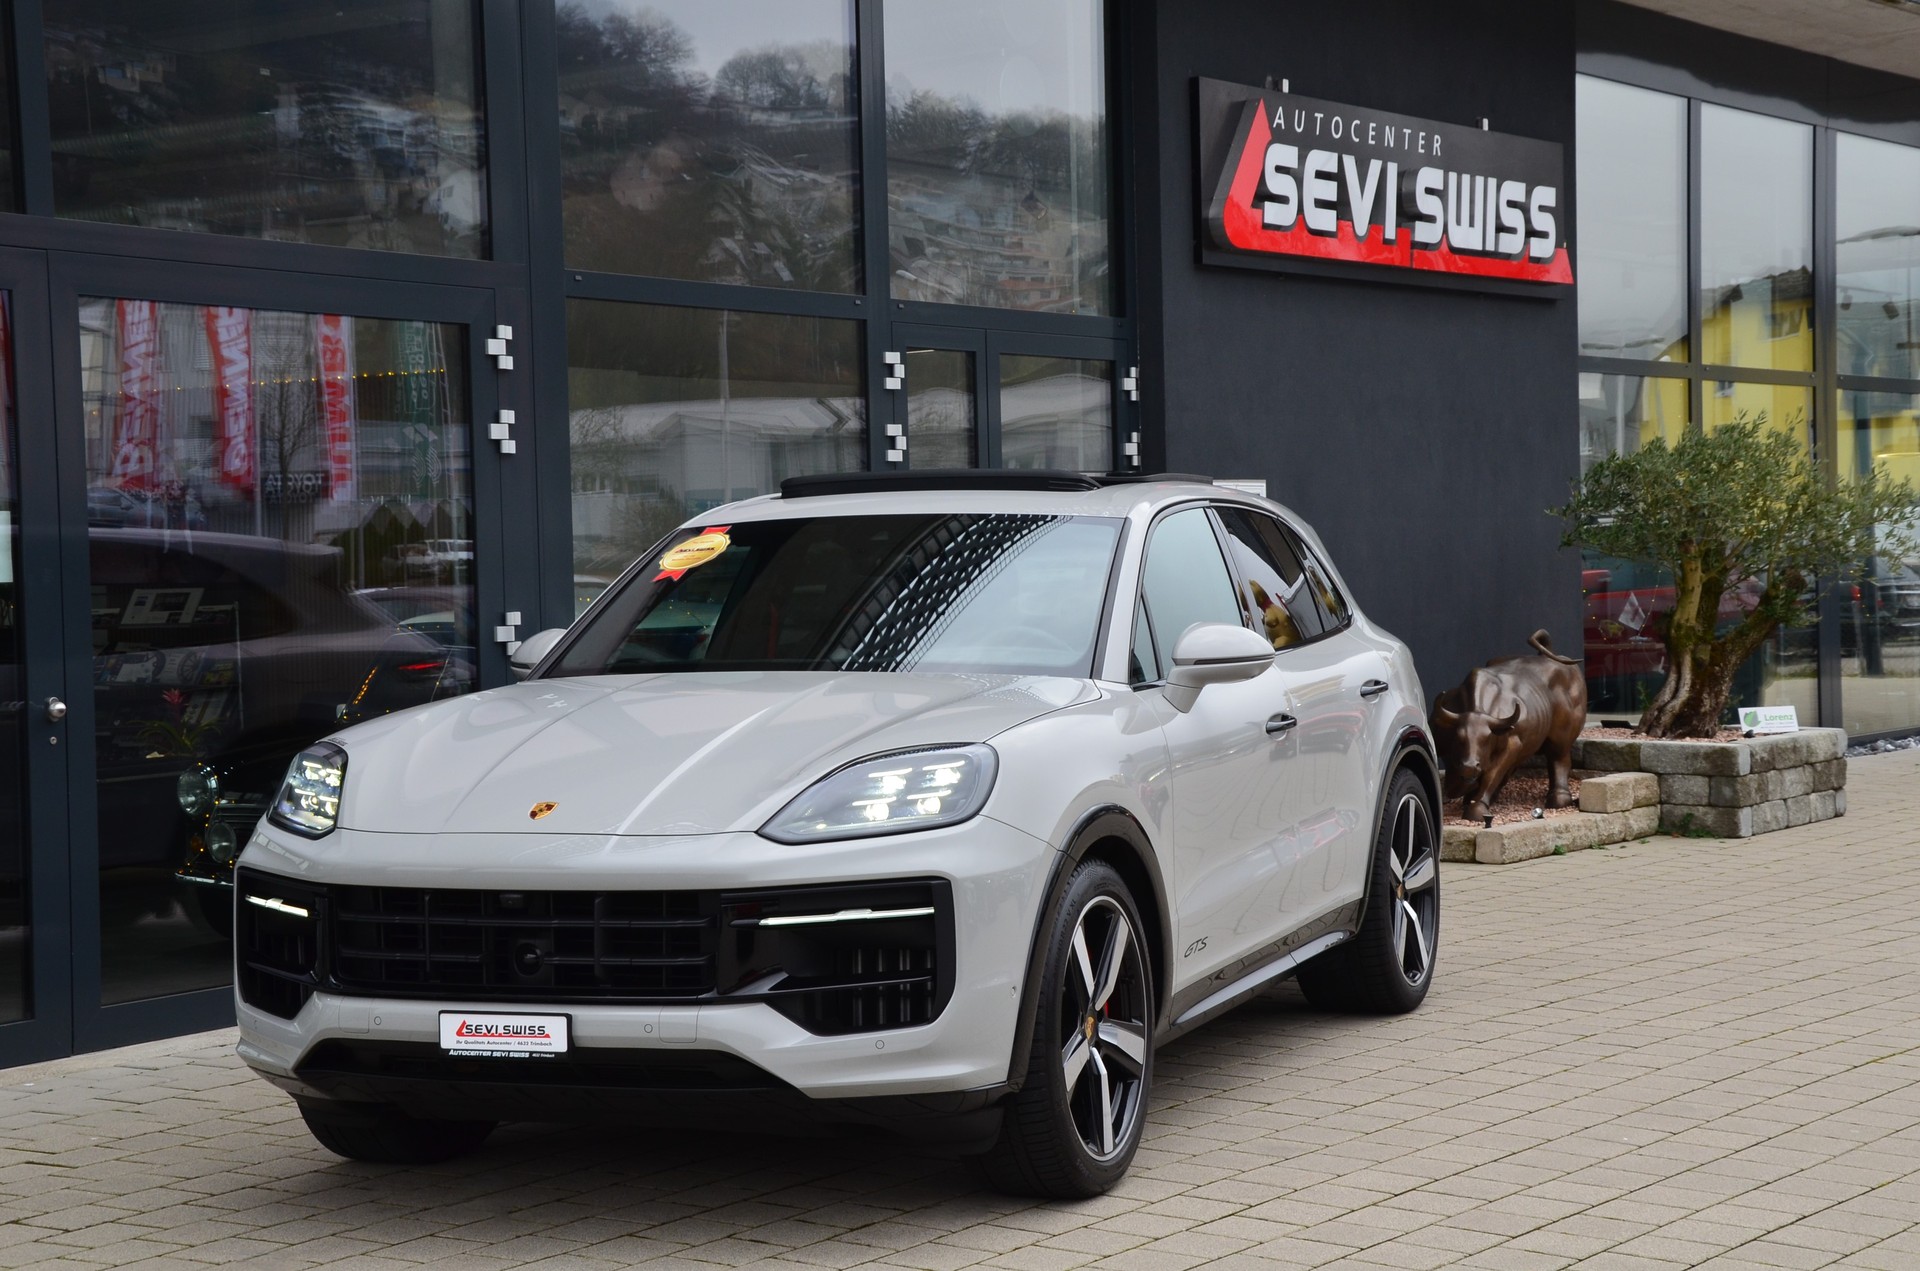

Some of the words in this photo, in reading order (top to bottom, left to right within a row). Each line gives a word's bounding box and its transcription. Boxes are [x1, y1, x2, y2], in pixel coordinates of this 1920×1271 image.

[1273, 105, 1442, 157] AUTOCENTER
[1262, 142, 1398, 240] SEVI
[1414, 166, 1557, 259] SWISS
[1764, 713, 1794, 721] Lorenz
[1184, 936, 1208, 958] GTS
[465, 1024, 498, 1034] SEVI
[503, 1025, 546, 1035] SWISS
